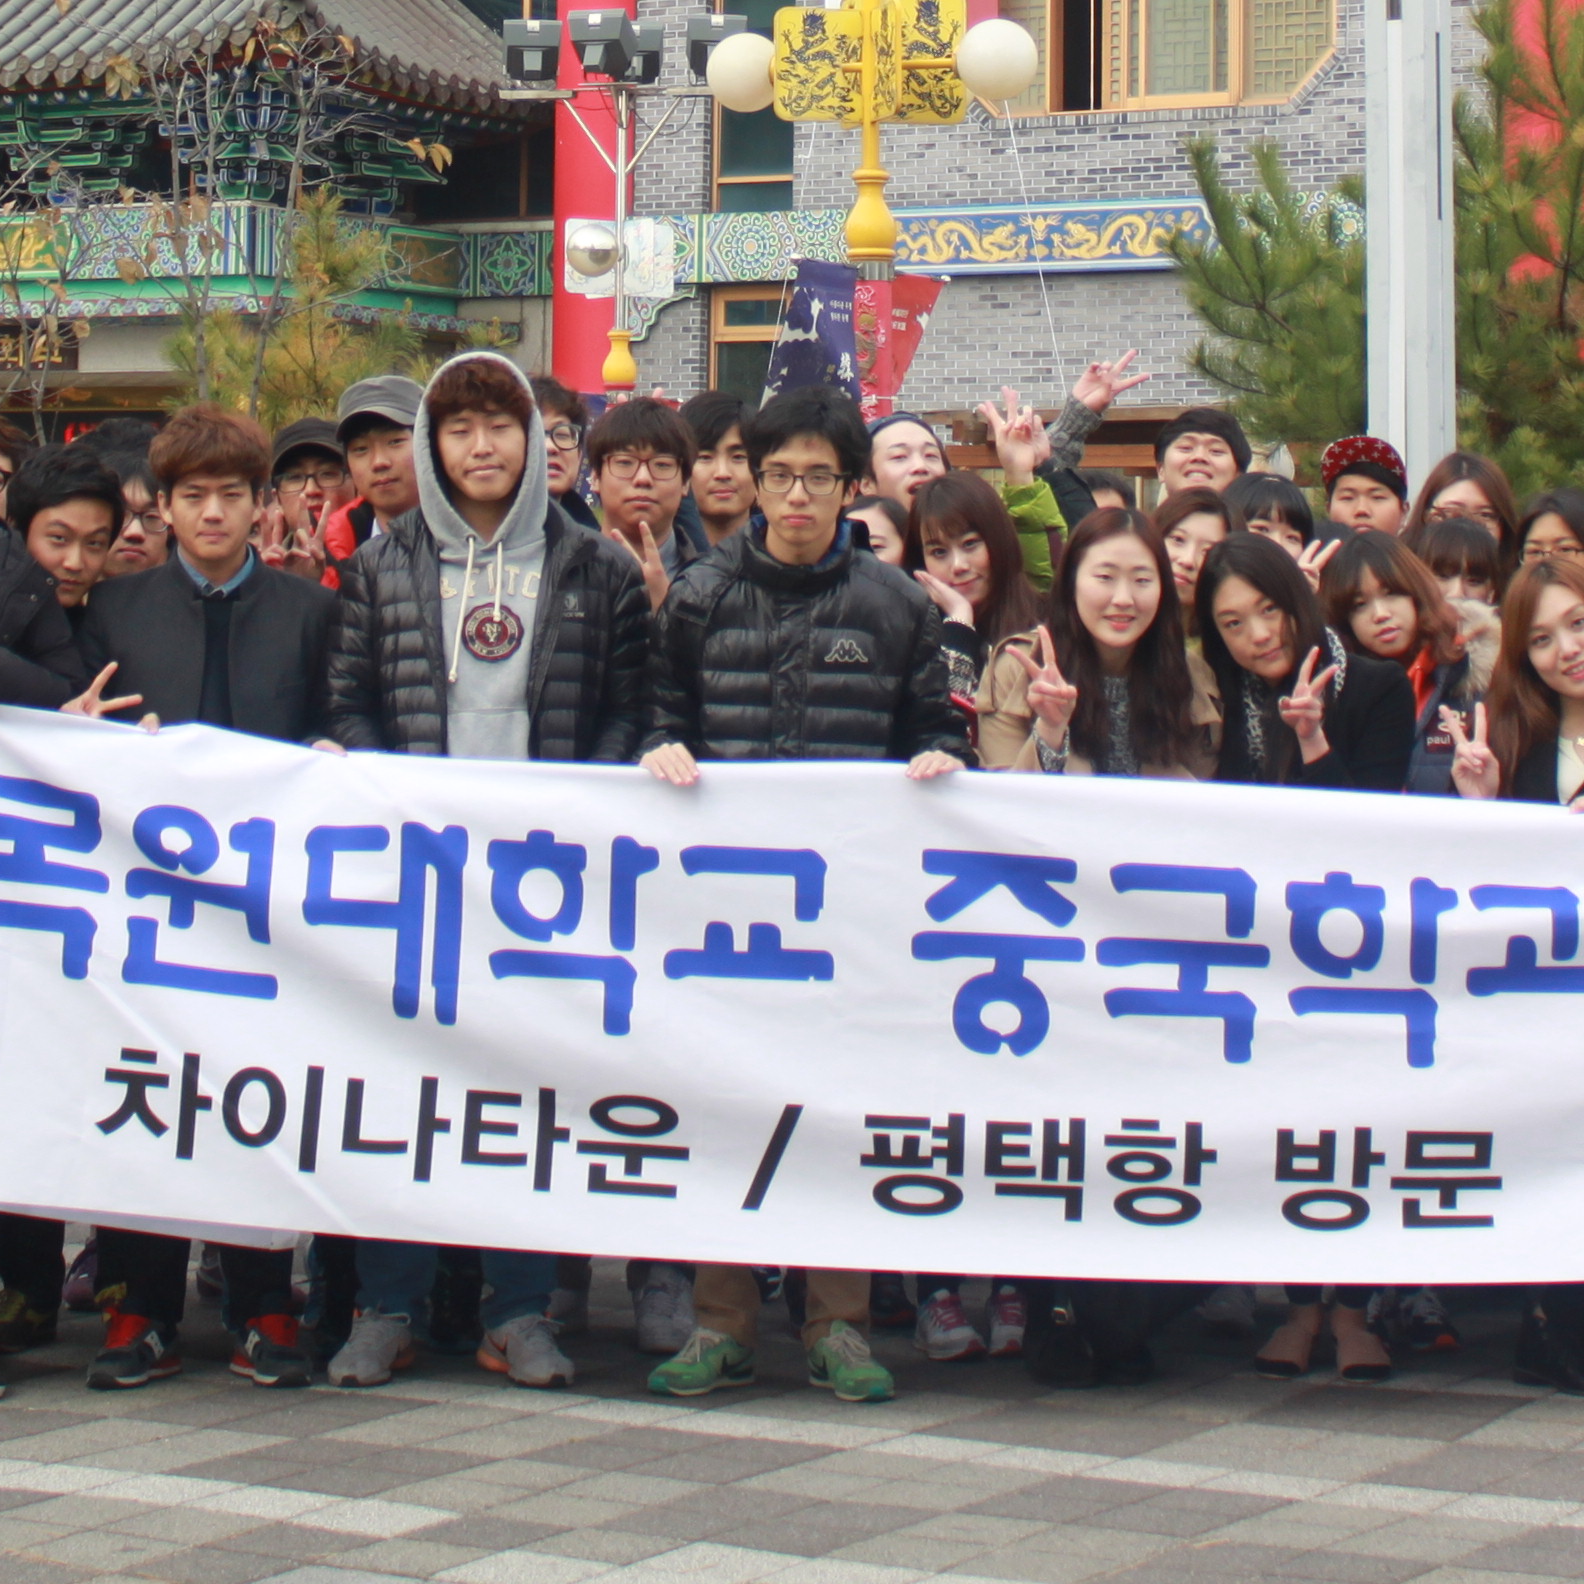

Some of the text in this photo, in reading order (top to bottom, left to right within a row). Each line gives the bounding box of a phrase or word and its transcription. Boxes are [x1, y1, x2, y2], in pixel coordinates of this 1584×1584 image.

[1426, 734, 1451, 747] paul
[94, 1046, 692, 1200] 차이나타운
[859, 1112, 1218, 1227] 평택항
[1274, 1126, 1504, 1232] 방문
